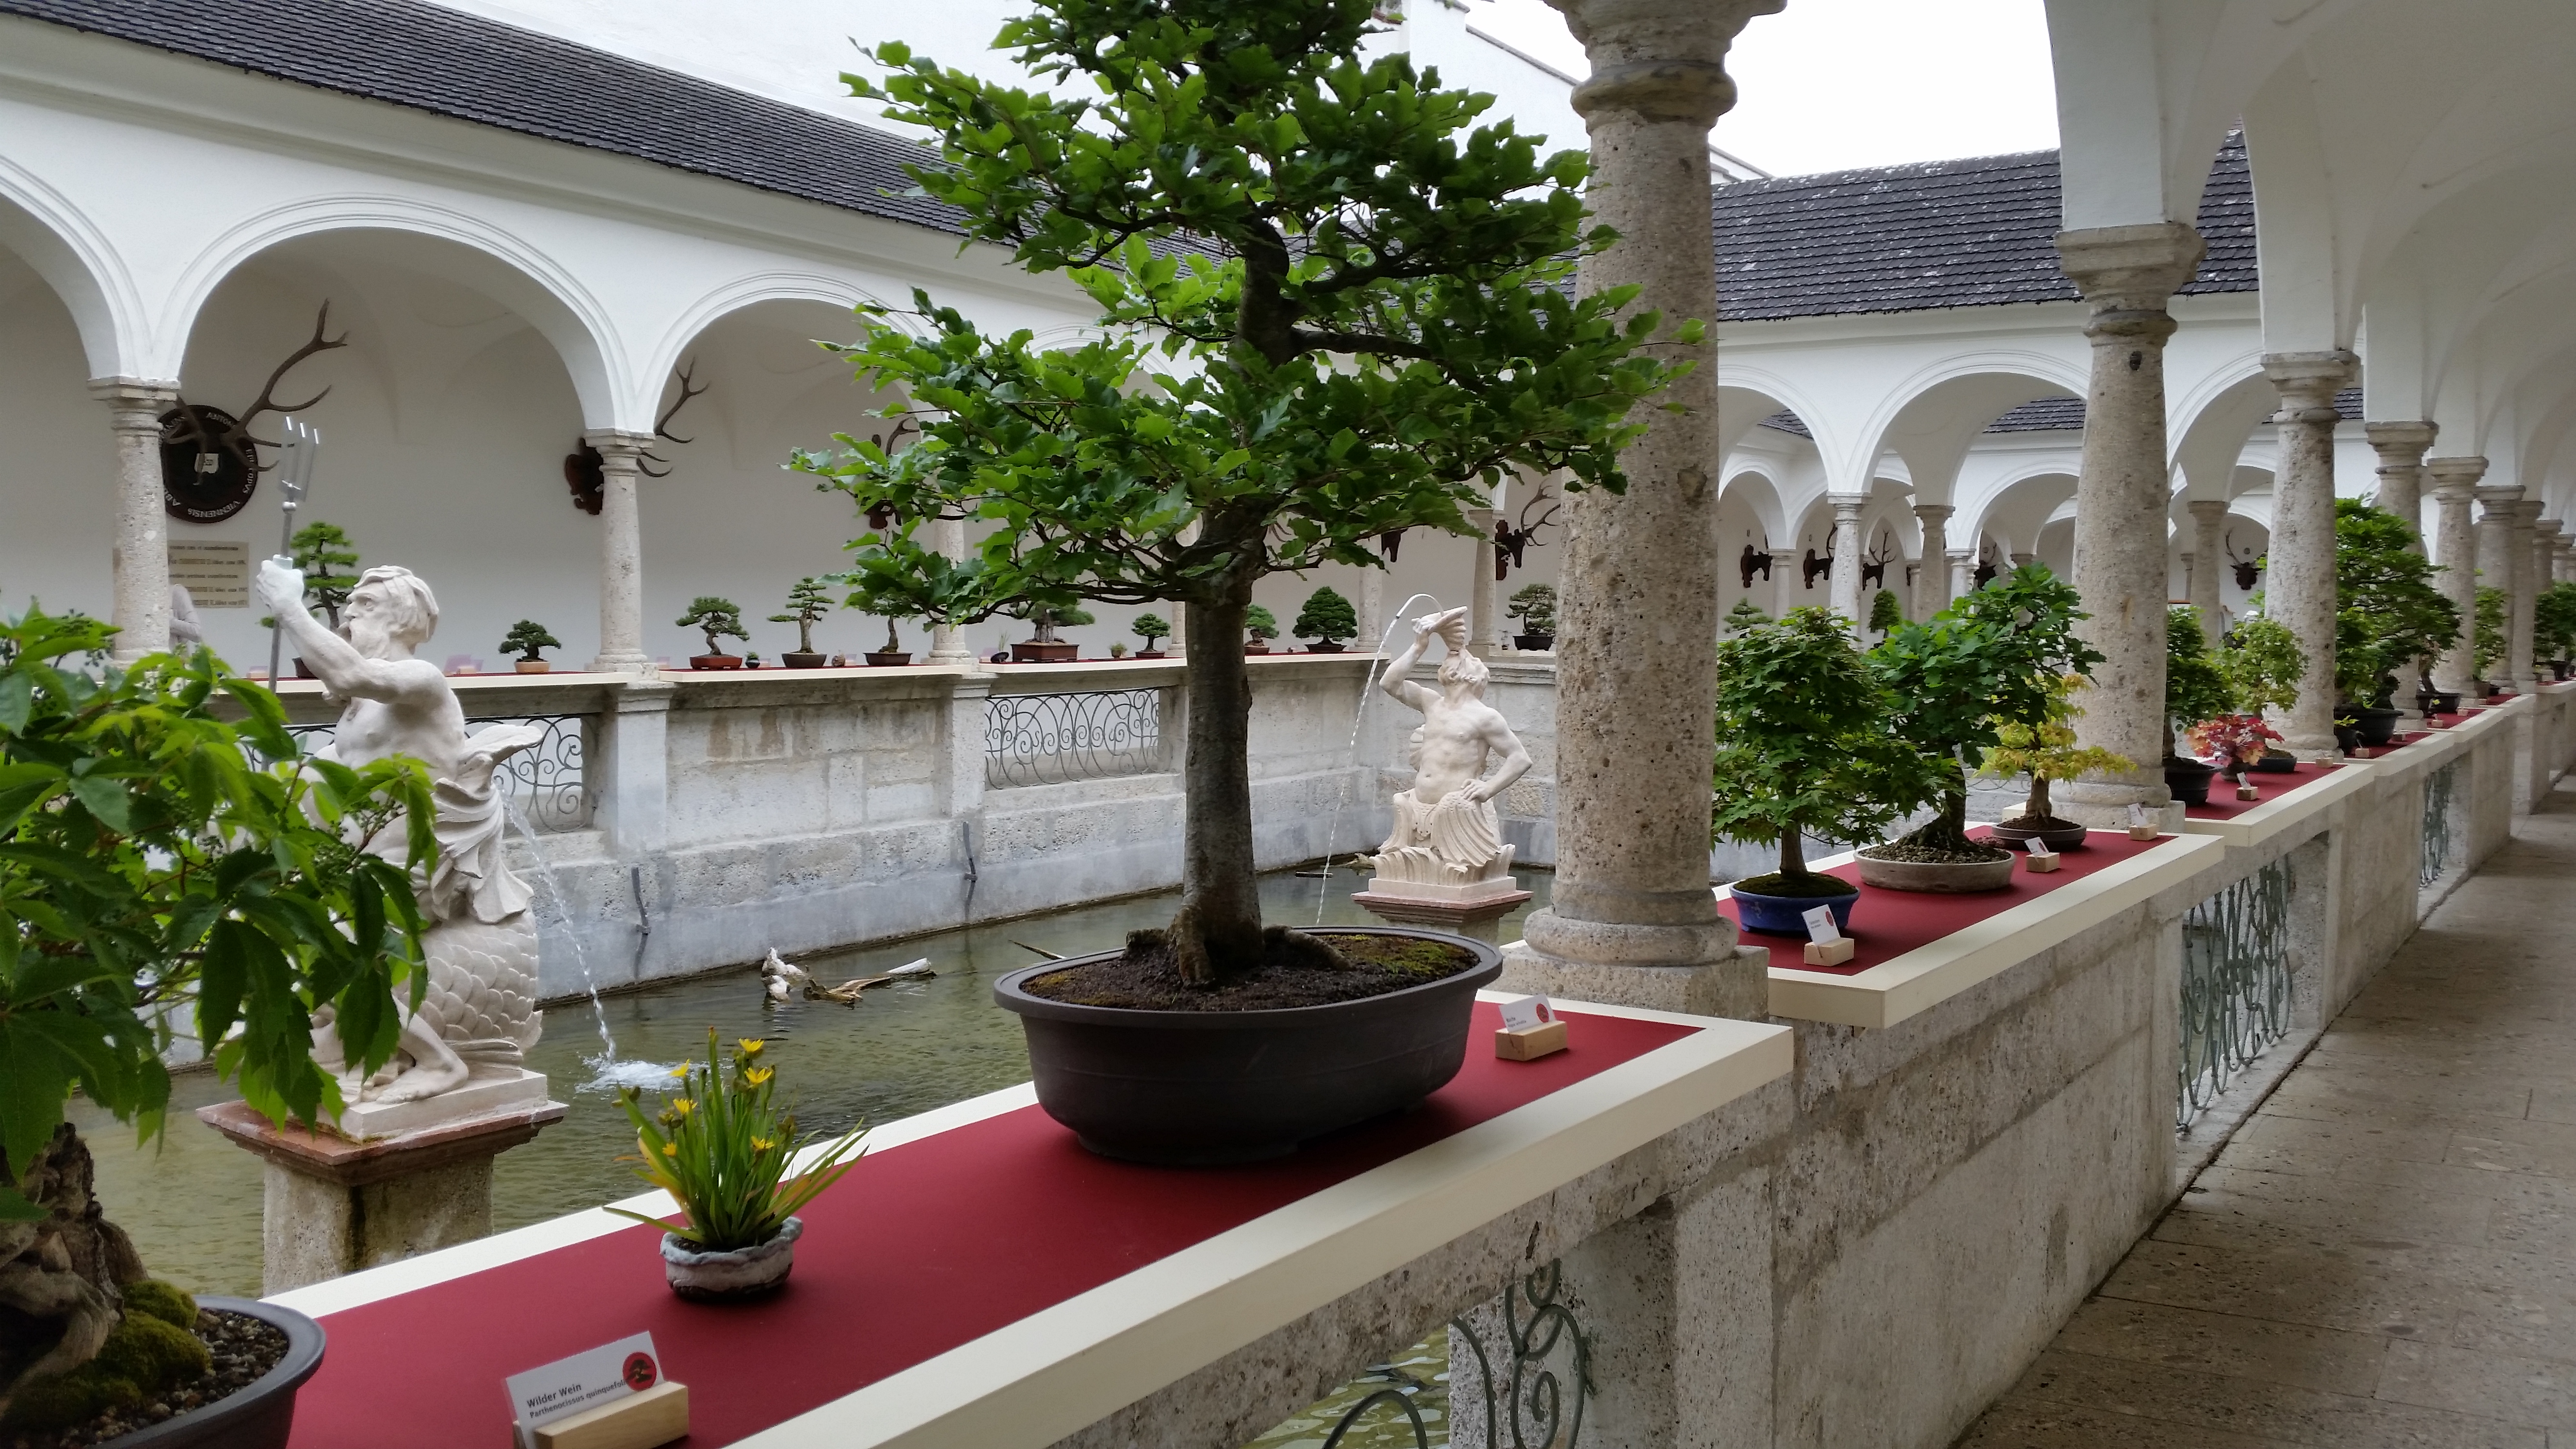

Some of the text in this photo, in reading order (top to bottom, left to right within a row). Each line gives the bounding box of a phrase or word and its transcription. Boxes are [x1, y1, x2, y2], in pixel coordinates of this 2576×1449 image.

[527, 1384, 581, 1408] Wilder Wein
[530, 1380, 627, 1418] Parthenocissus quinquefoli
